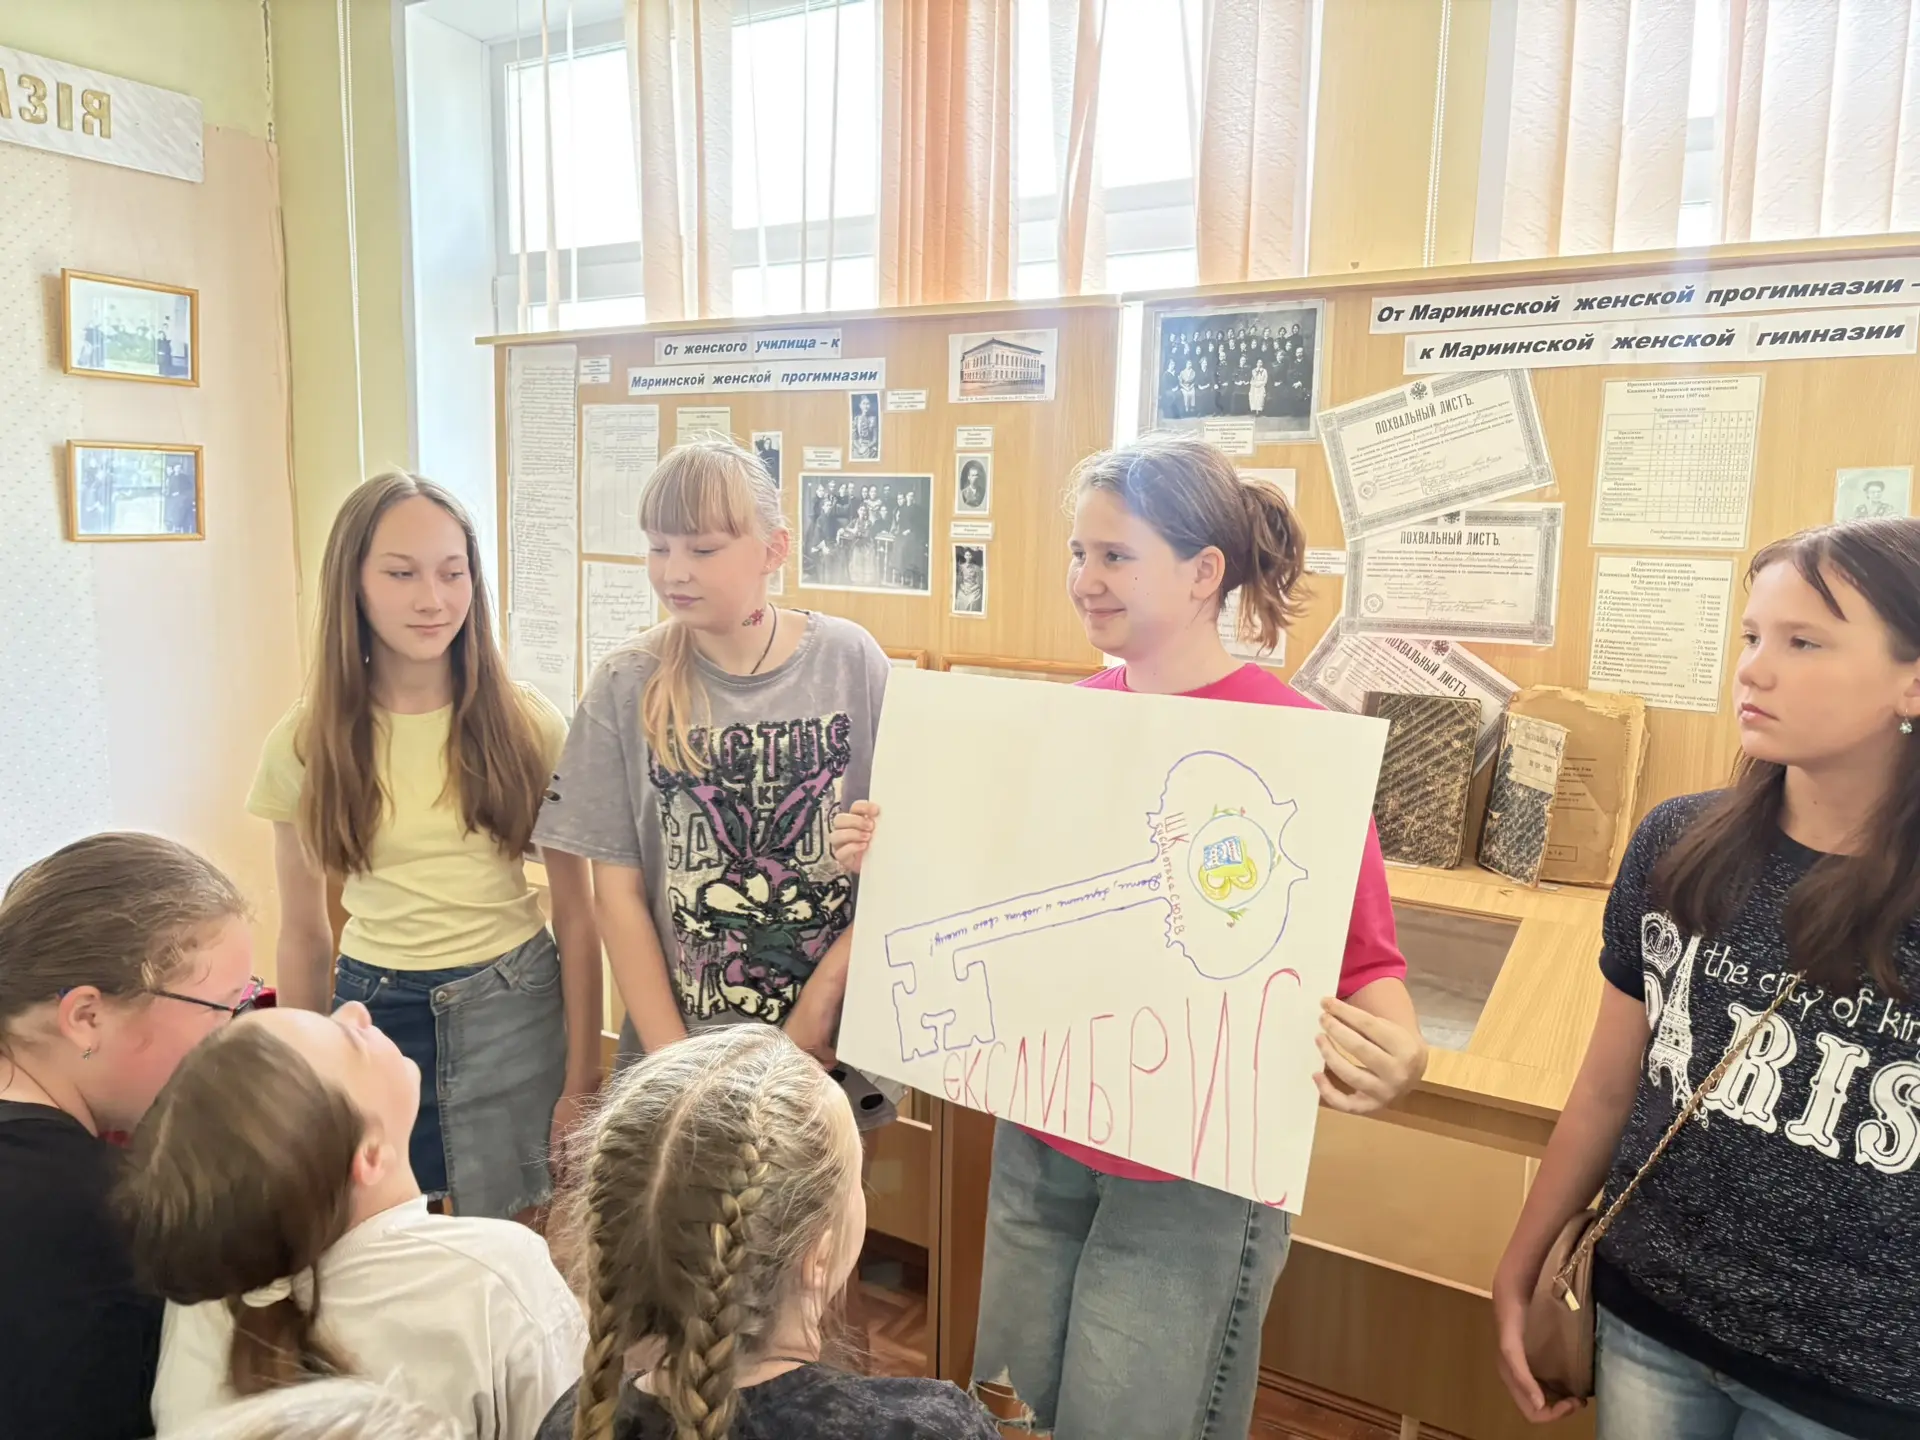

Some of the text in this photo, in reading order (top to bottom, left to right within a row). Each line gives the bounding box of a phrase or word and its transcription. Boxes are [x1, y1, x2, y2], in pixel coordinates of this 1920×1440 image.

[1377, 306, 1404, 322] От
[1408, 295, 1561, 323] Мариинской
[1573, 285, 1696, 312] женской
[1704, 277, 1905, 307] прогимназии
[664, 344, 678, 356] От
[684, 342, 747, 354] женского
[754, 337, 816, 353] училища
[830, 337, 840, 348] к
[1419, 323, 1905, 361] к Мариинской женской гимназии
[631, 370, 877, 390] Мариинской женской прогимназии
[1375, 403, 1437, 435] ПОХВАЛЬНЫЙ
[1400, 530, 1462, 545] ПОХВАЛЬНЫЙ
[1703, 942, 1749, 985] the
[1832, 988, 1874, 1027] of
